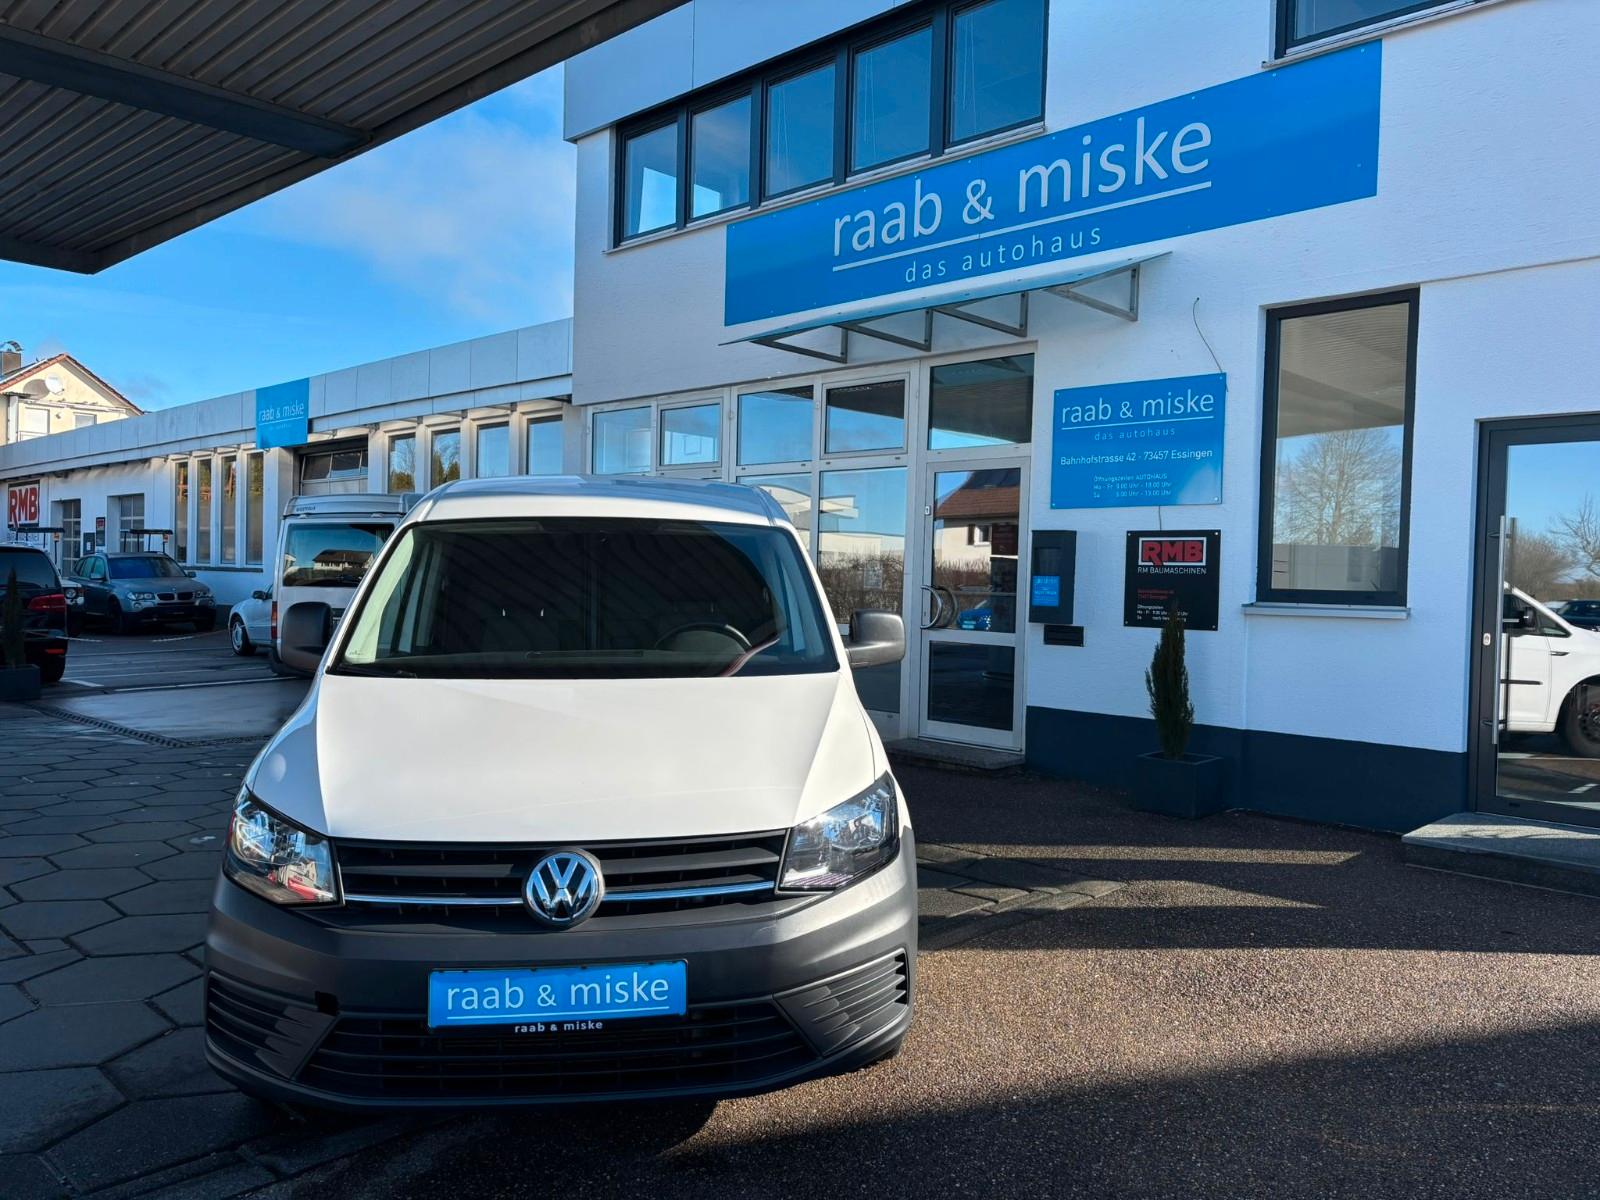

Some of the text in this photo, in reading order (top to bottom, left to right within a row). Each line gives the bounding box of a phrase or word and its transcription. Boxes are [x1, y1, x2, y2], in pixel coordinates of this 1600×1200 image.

[833, 116, 1212, 256] raab & miske
[905, 227, 1102, 284] das autohaus
[259, 405, 275, 421] raab
[283, 400, 304, 417] miske
[1062, 389, 1215, 424] raab & miske
[1094, 428, 1176, 441] das autohaus
[1060, 453, 1124, 466] Bahnhofstrasse
[1126, 452, 1137, 462] 42
[1143, 450, 1169, 462] 73457
[1171, 448, 1213, 461] Essingen
[9, 487, 38, 528] RMB
[1142, 540, 1203, 566] RMB
[1150, 567, 1207, 576] BAUMASCHINEN
[447, 972, 669, 1010] raab & miske
[514, 1020, 603, 1033] raab & miske
